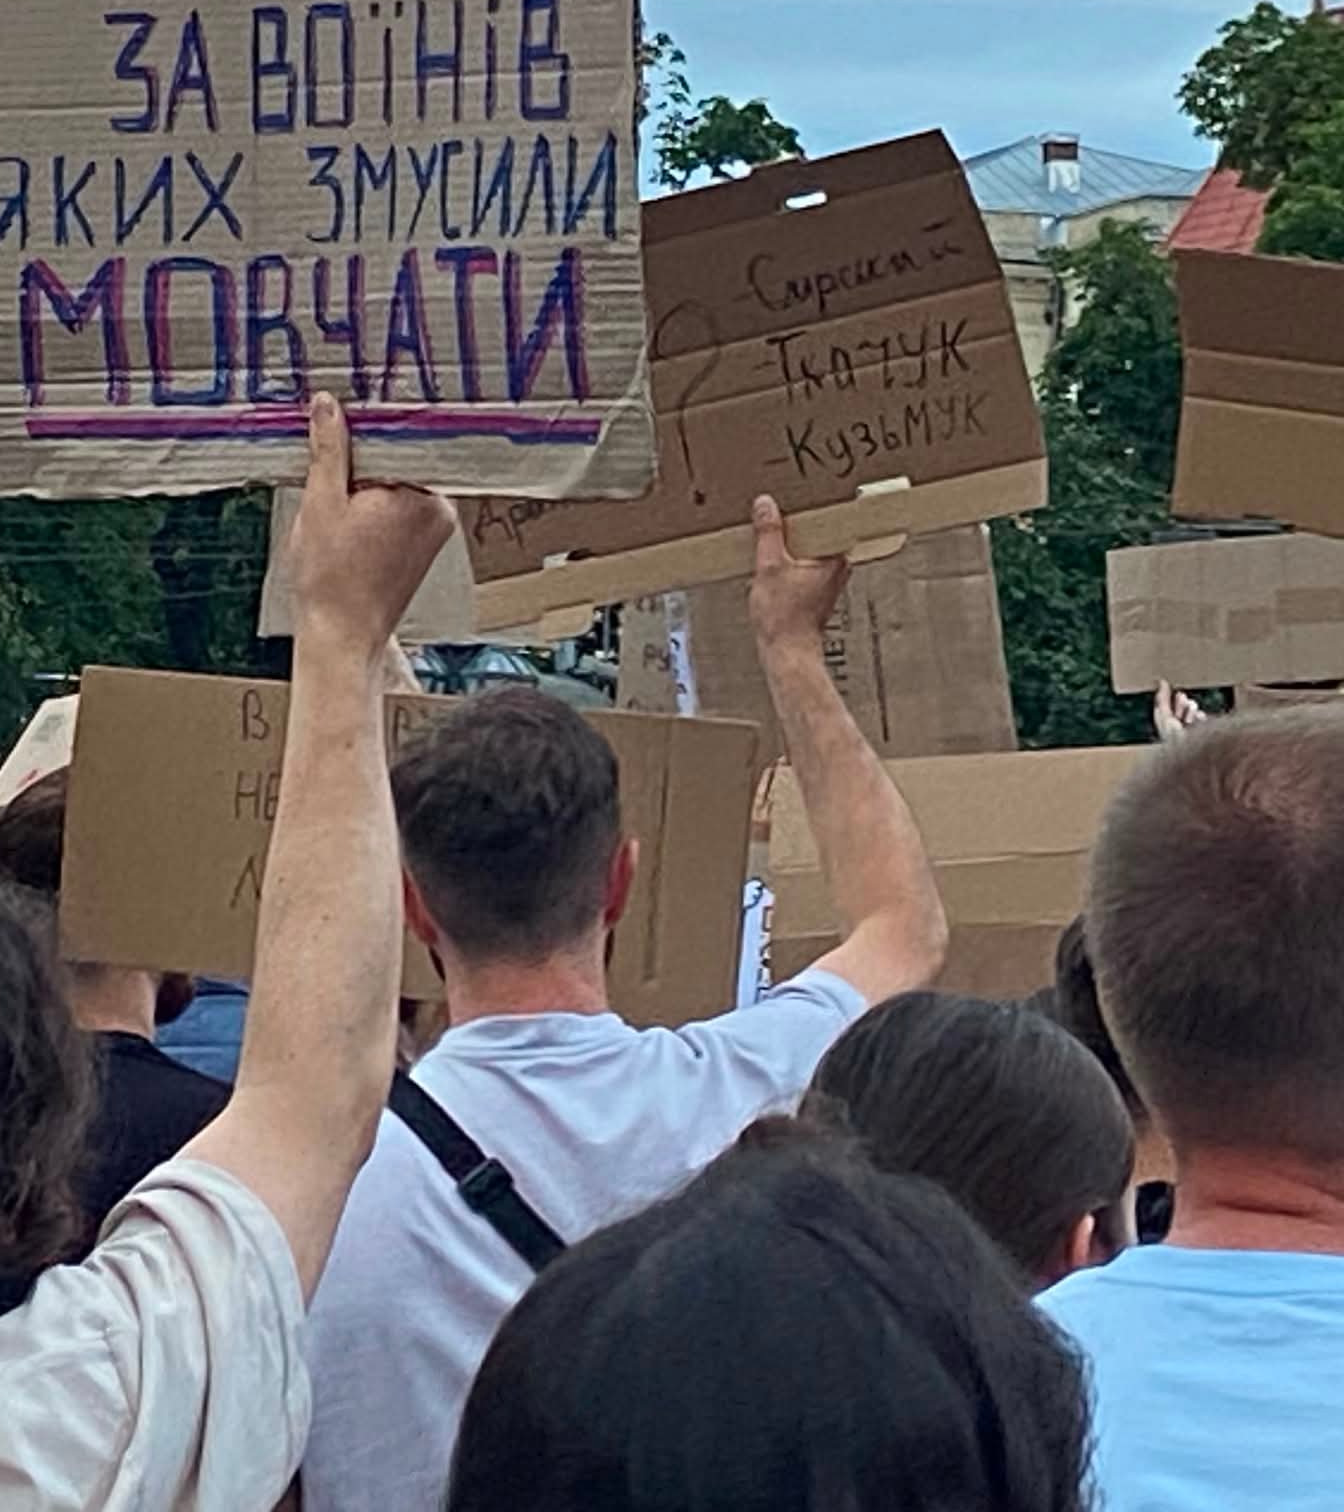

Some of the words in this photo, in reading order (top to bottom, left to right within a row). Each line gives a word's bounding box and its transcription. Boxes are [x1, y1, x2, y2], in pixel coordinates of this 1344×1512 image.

[103, 7, 218, 134] ЗА
[304, 128, 618, 243] ЗМУСИЛИ
[18, 245, 592, 408] МОВЧАТИ
